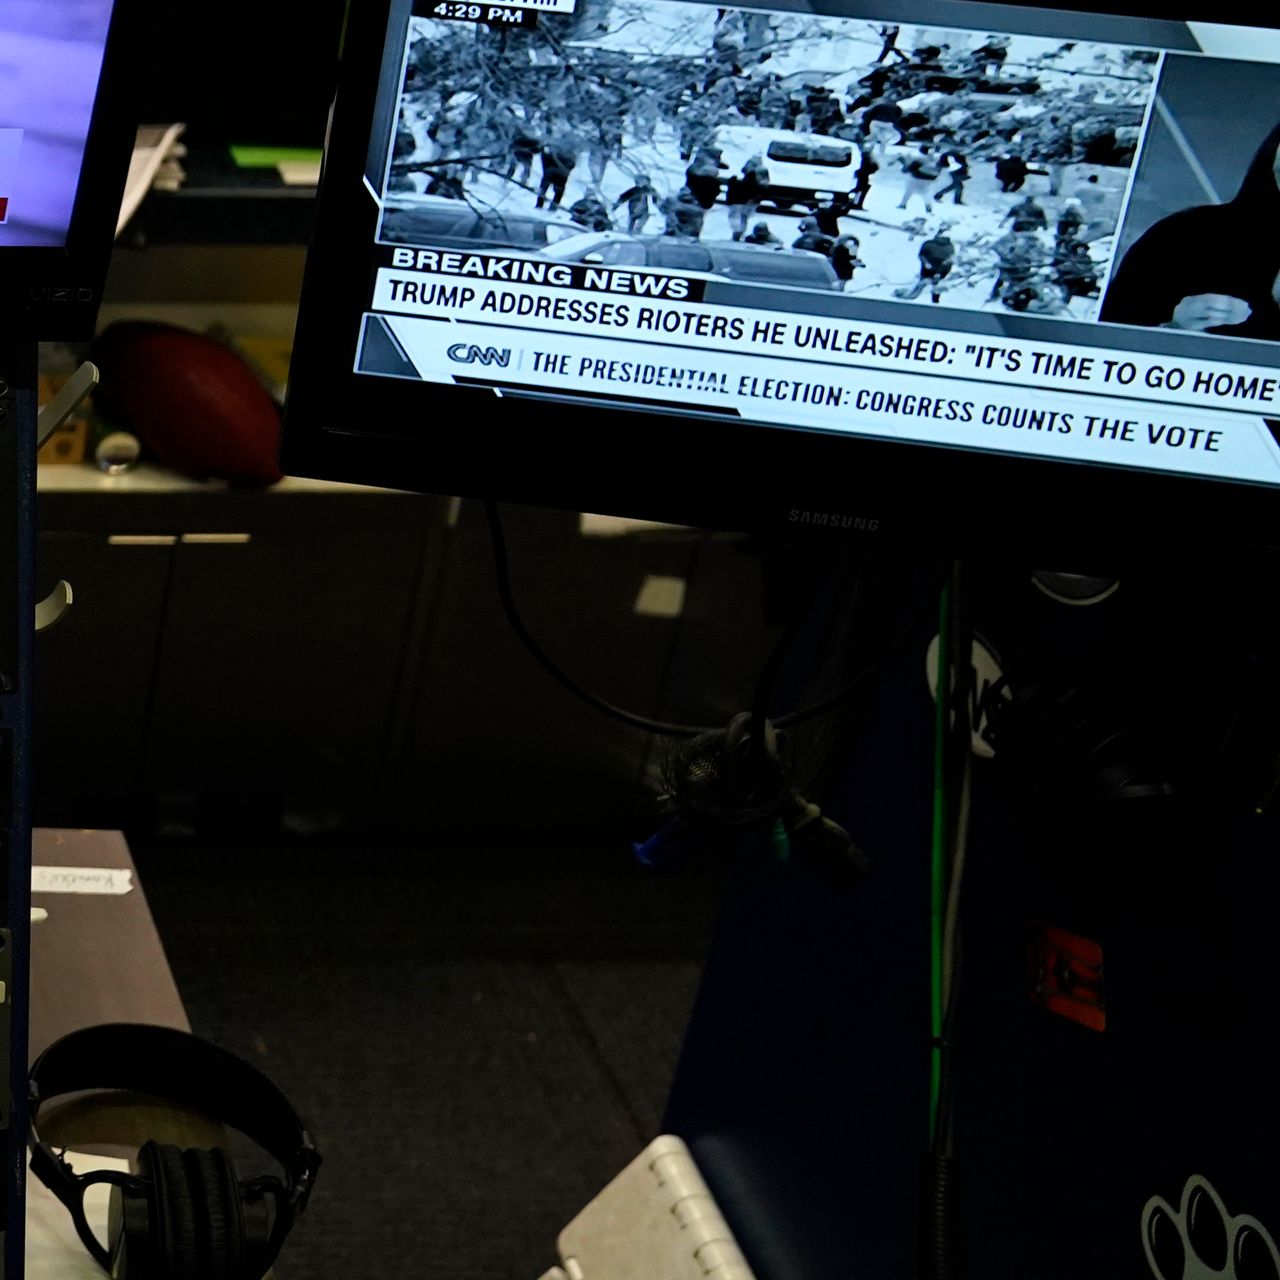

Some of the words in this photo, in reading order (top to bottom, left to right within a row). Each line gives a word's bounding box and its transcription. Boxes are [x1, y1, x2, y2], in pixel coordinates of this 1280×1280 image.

[433, 2, 481, 20] 4:29
[488, 7, 523, 24] PM
[391, 247, 573, 287] BREAKING
[583, 268, 690, 299] NEWS
[388, 278, 476, 310] TRUMP
[480, 288, 630, 329] ADDRESSES
[635, 309, 745, 342] RIOTERS
[751, 320, 785, 346] HE
[792, 324, 956, 366] UNLEASHED:
[964, 344, 1022, 373] "IT'S
[1030, 351, 1094, 380] TIME
[1103, 359, 1138, 385] TO
[1143, 365, 1185, 391] GO
[446, 343, 511, 369] CNN
[532, 351, 570, 376] THE
[577, 354, 730, 396] PRESIDENTIAL
[737, 375, 852, 408] ELECTION:
[855, 389, 975, 424] CONGRESS
[981, 404, 1074, 436] COUNTS
[1083, 416, 1139, 444] THE
[1146, 423, 1224, 453] VOTE
[787, 508, 880, 532] SAMSUNG
